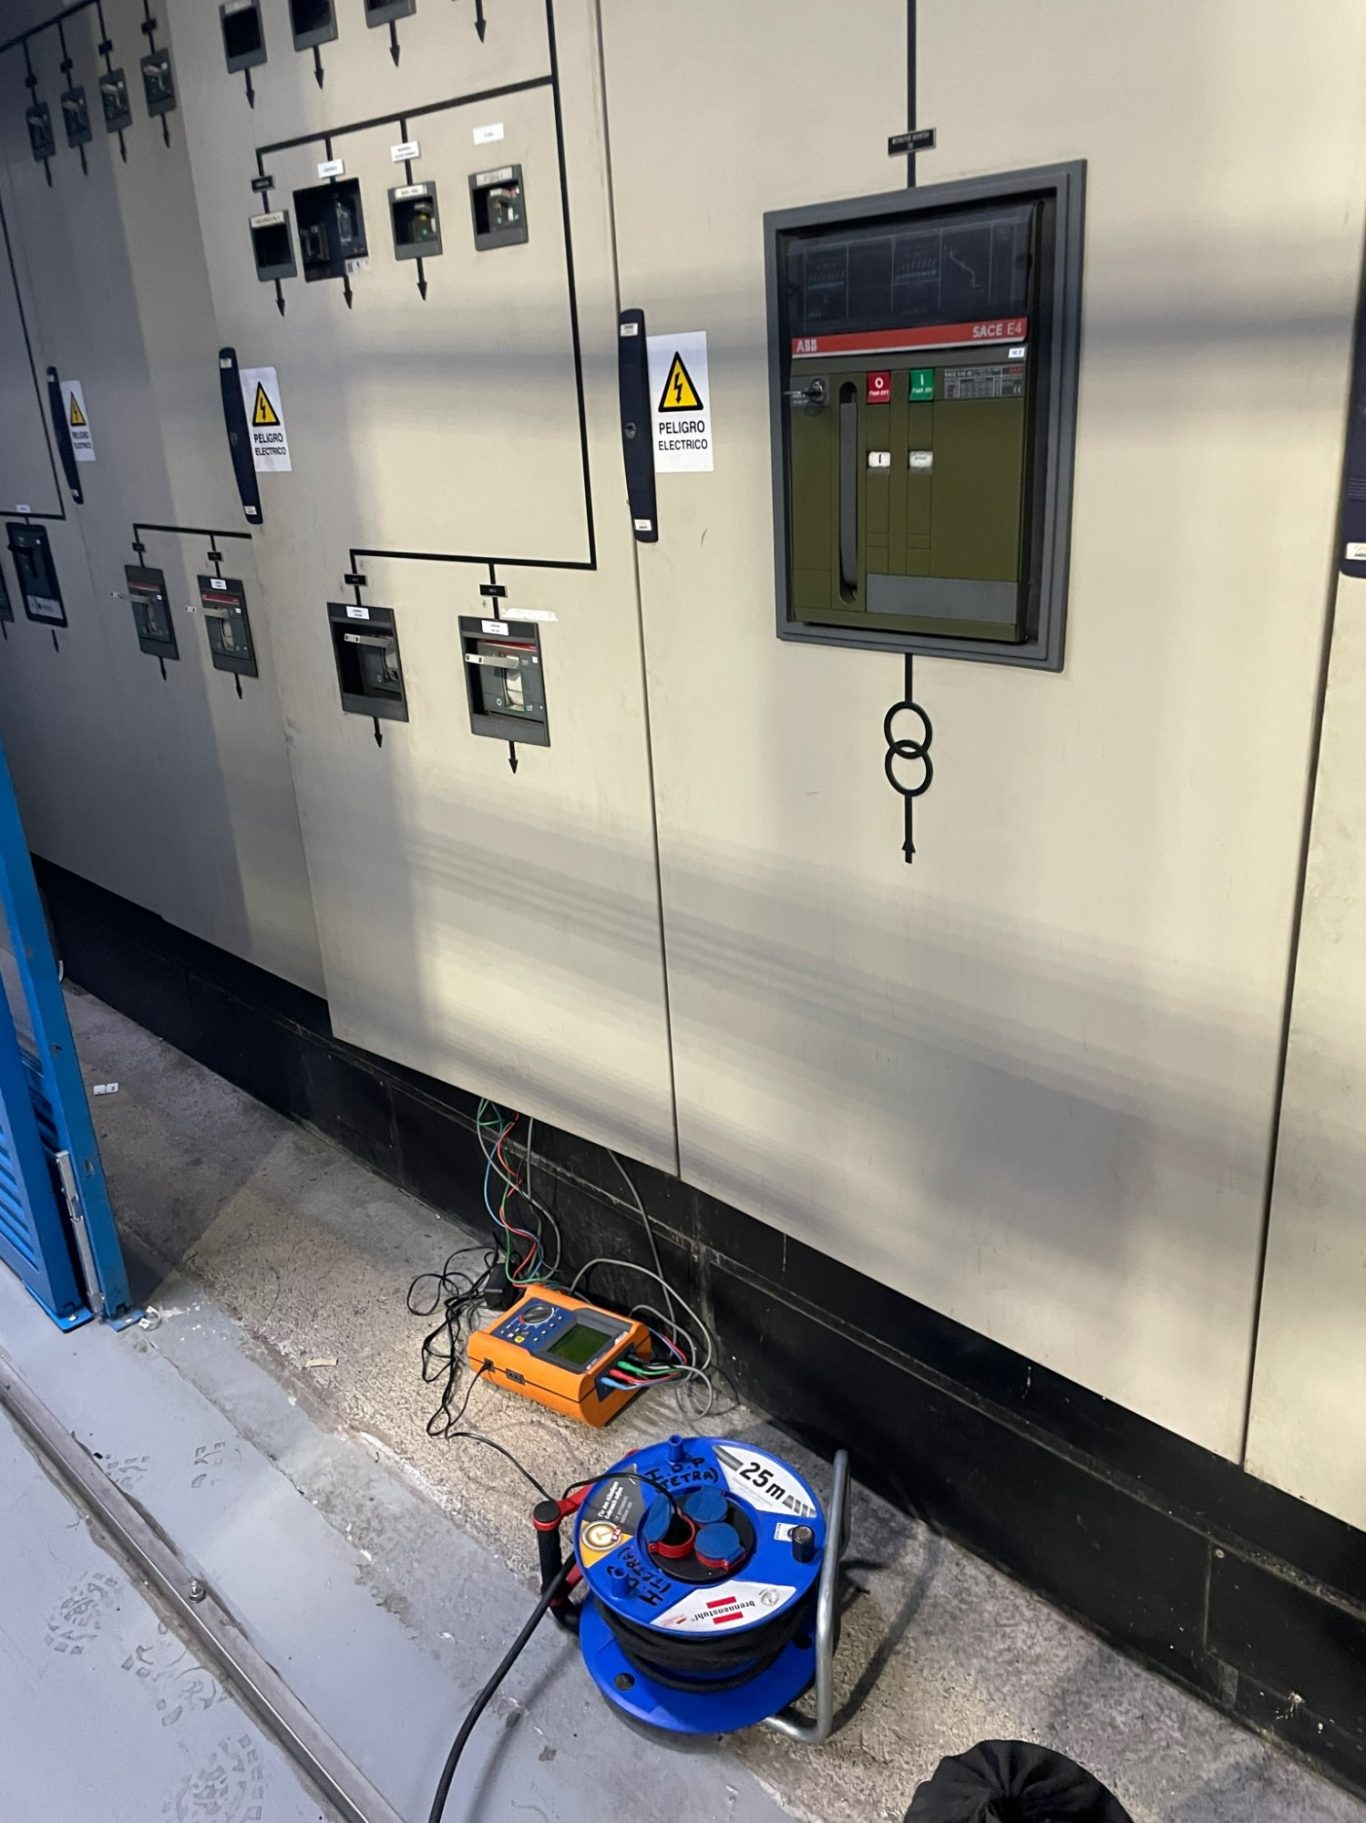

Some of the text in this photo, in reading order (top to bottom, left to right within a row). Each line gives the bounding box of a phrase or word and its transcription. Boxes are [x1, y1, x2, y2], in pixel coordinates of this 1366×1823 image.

[972, 321, 1022, 338] SACE E4
[796, 339, 818, 353] ABB
[658, 420, 706, 435] PELIGRO
[253, 432, 284, 444] PELIGRO
[658, 438, 708, 451] ELECTRICO
[254, 446, 287, 456] ELECTRICO
[655, 1467, 719, 1491] TETRA)
[693, 1600, 756, 1622] brennenstuhl
